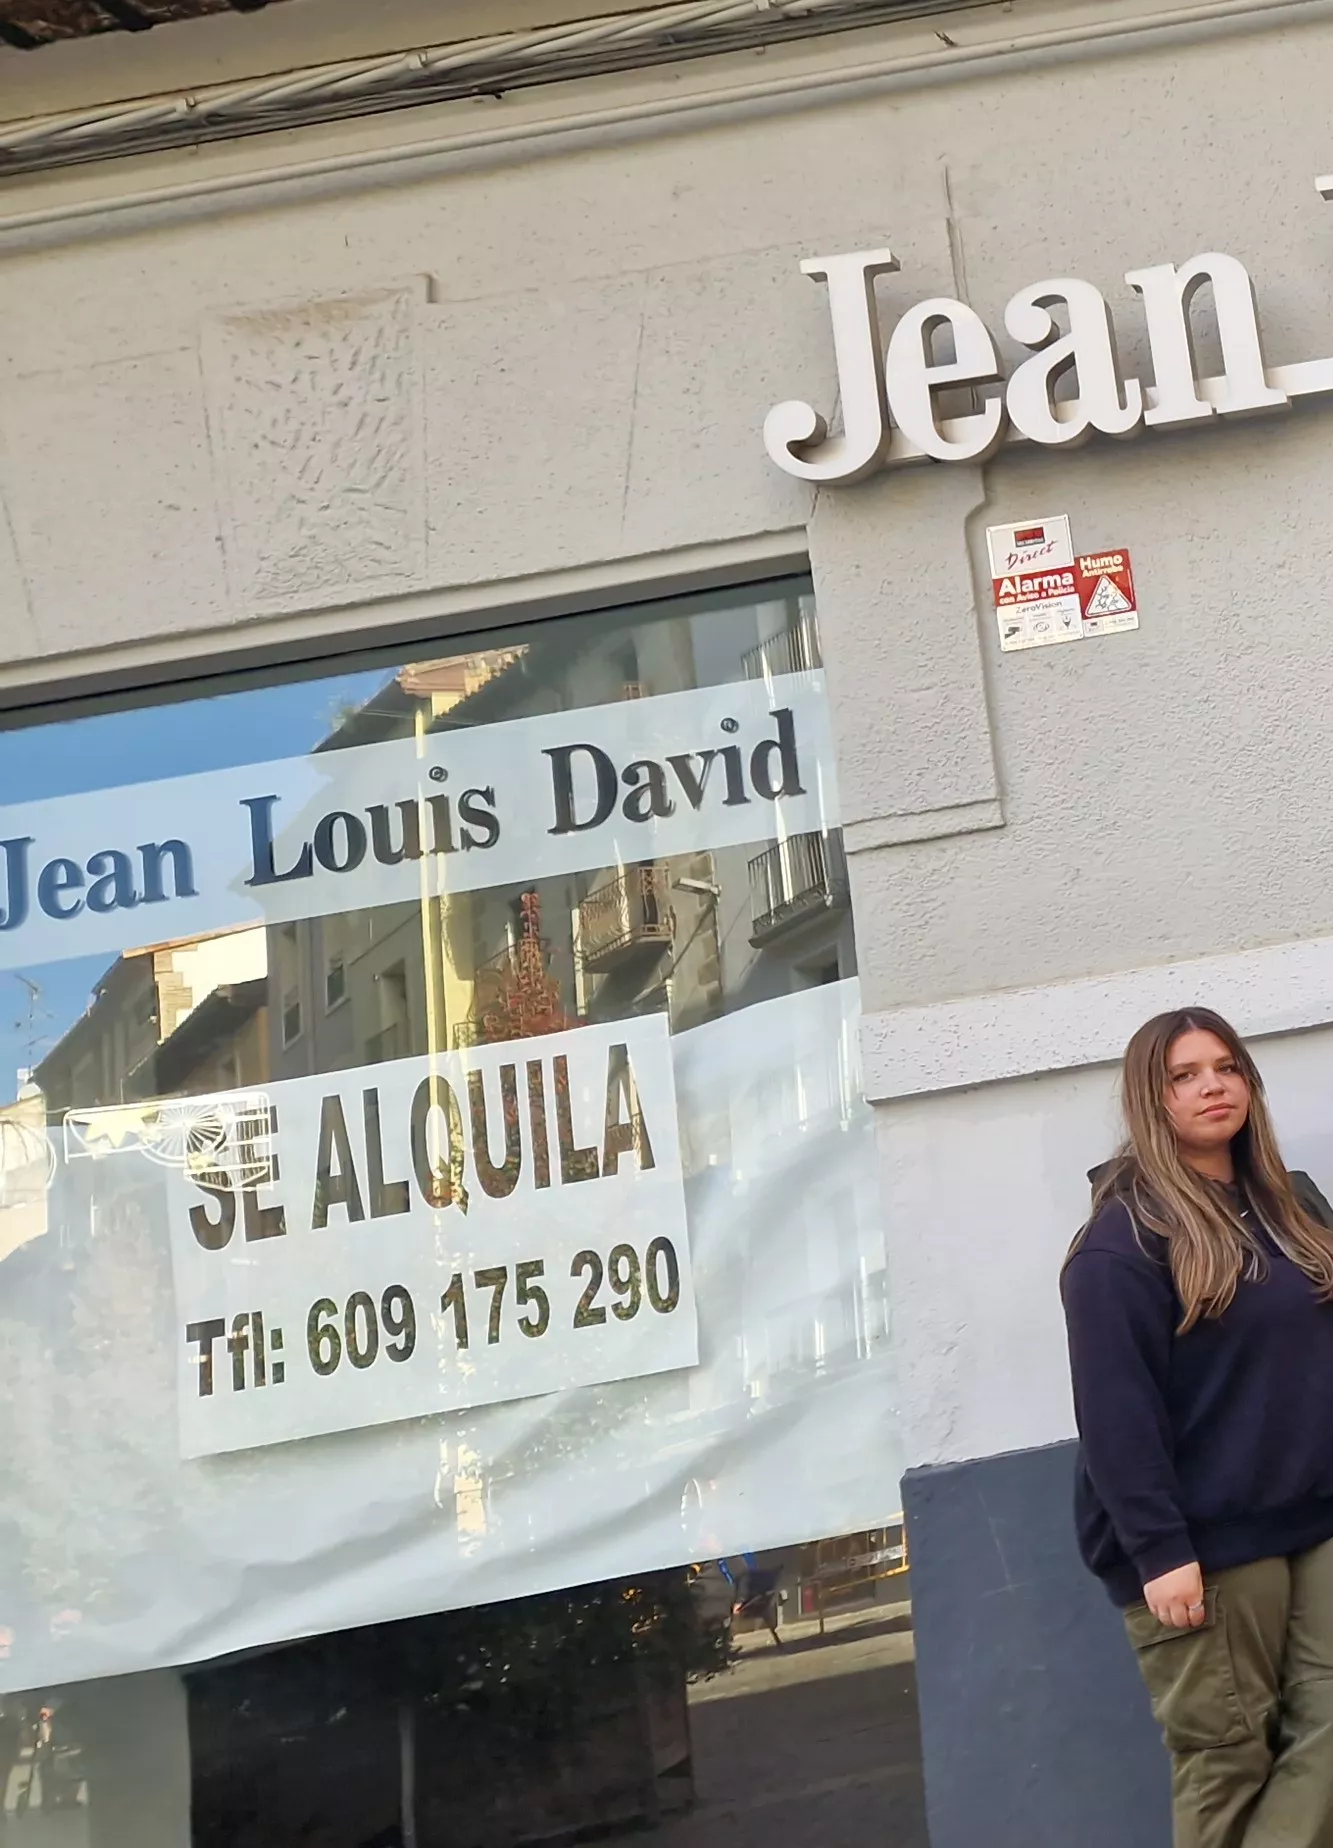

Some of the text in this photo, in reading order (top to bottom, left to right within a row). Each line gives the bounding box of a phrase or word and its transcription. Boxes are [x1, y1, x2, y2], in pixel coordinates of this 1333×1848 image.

[763, 247, 1290, 484] Jean
[998, 571, 1074, 597] Alarma
[999, 595, 1016, 605] con
[1016, 590, 1040, 602] Aviso
[1004, 538, 1060, 571] Direct
[1079, 553, 1124, 571] Humo
[0, 708, 806, 934] Jean Louis David
[185, 1042, 657, 1253] SE ALQUILA
[185, 1234, 681, 1398] Tfl: 609 175 290
